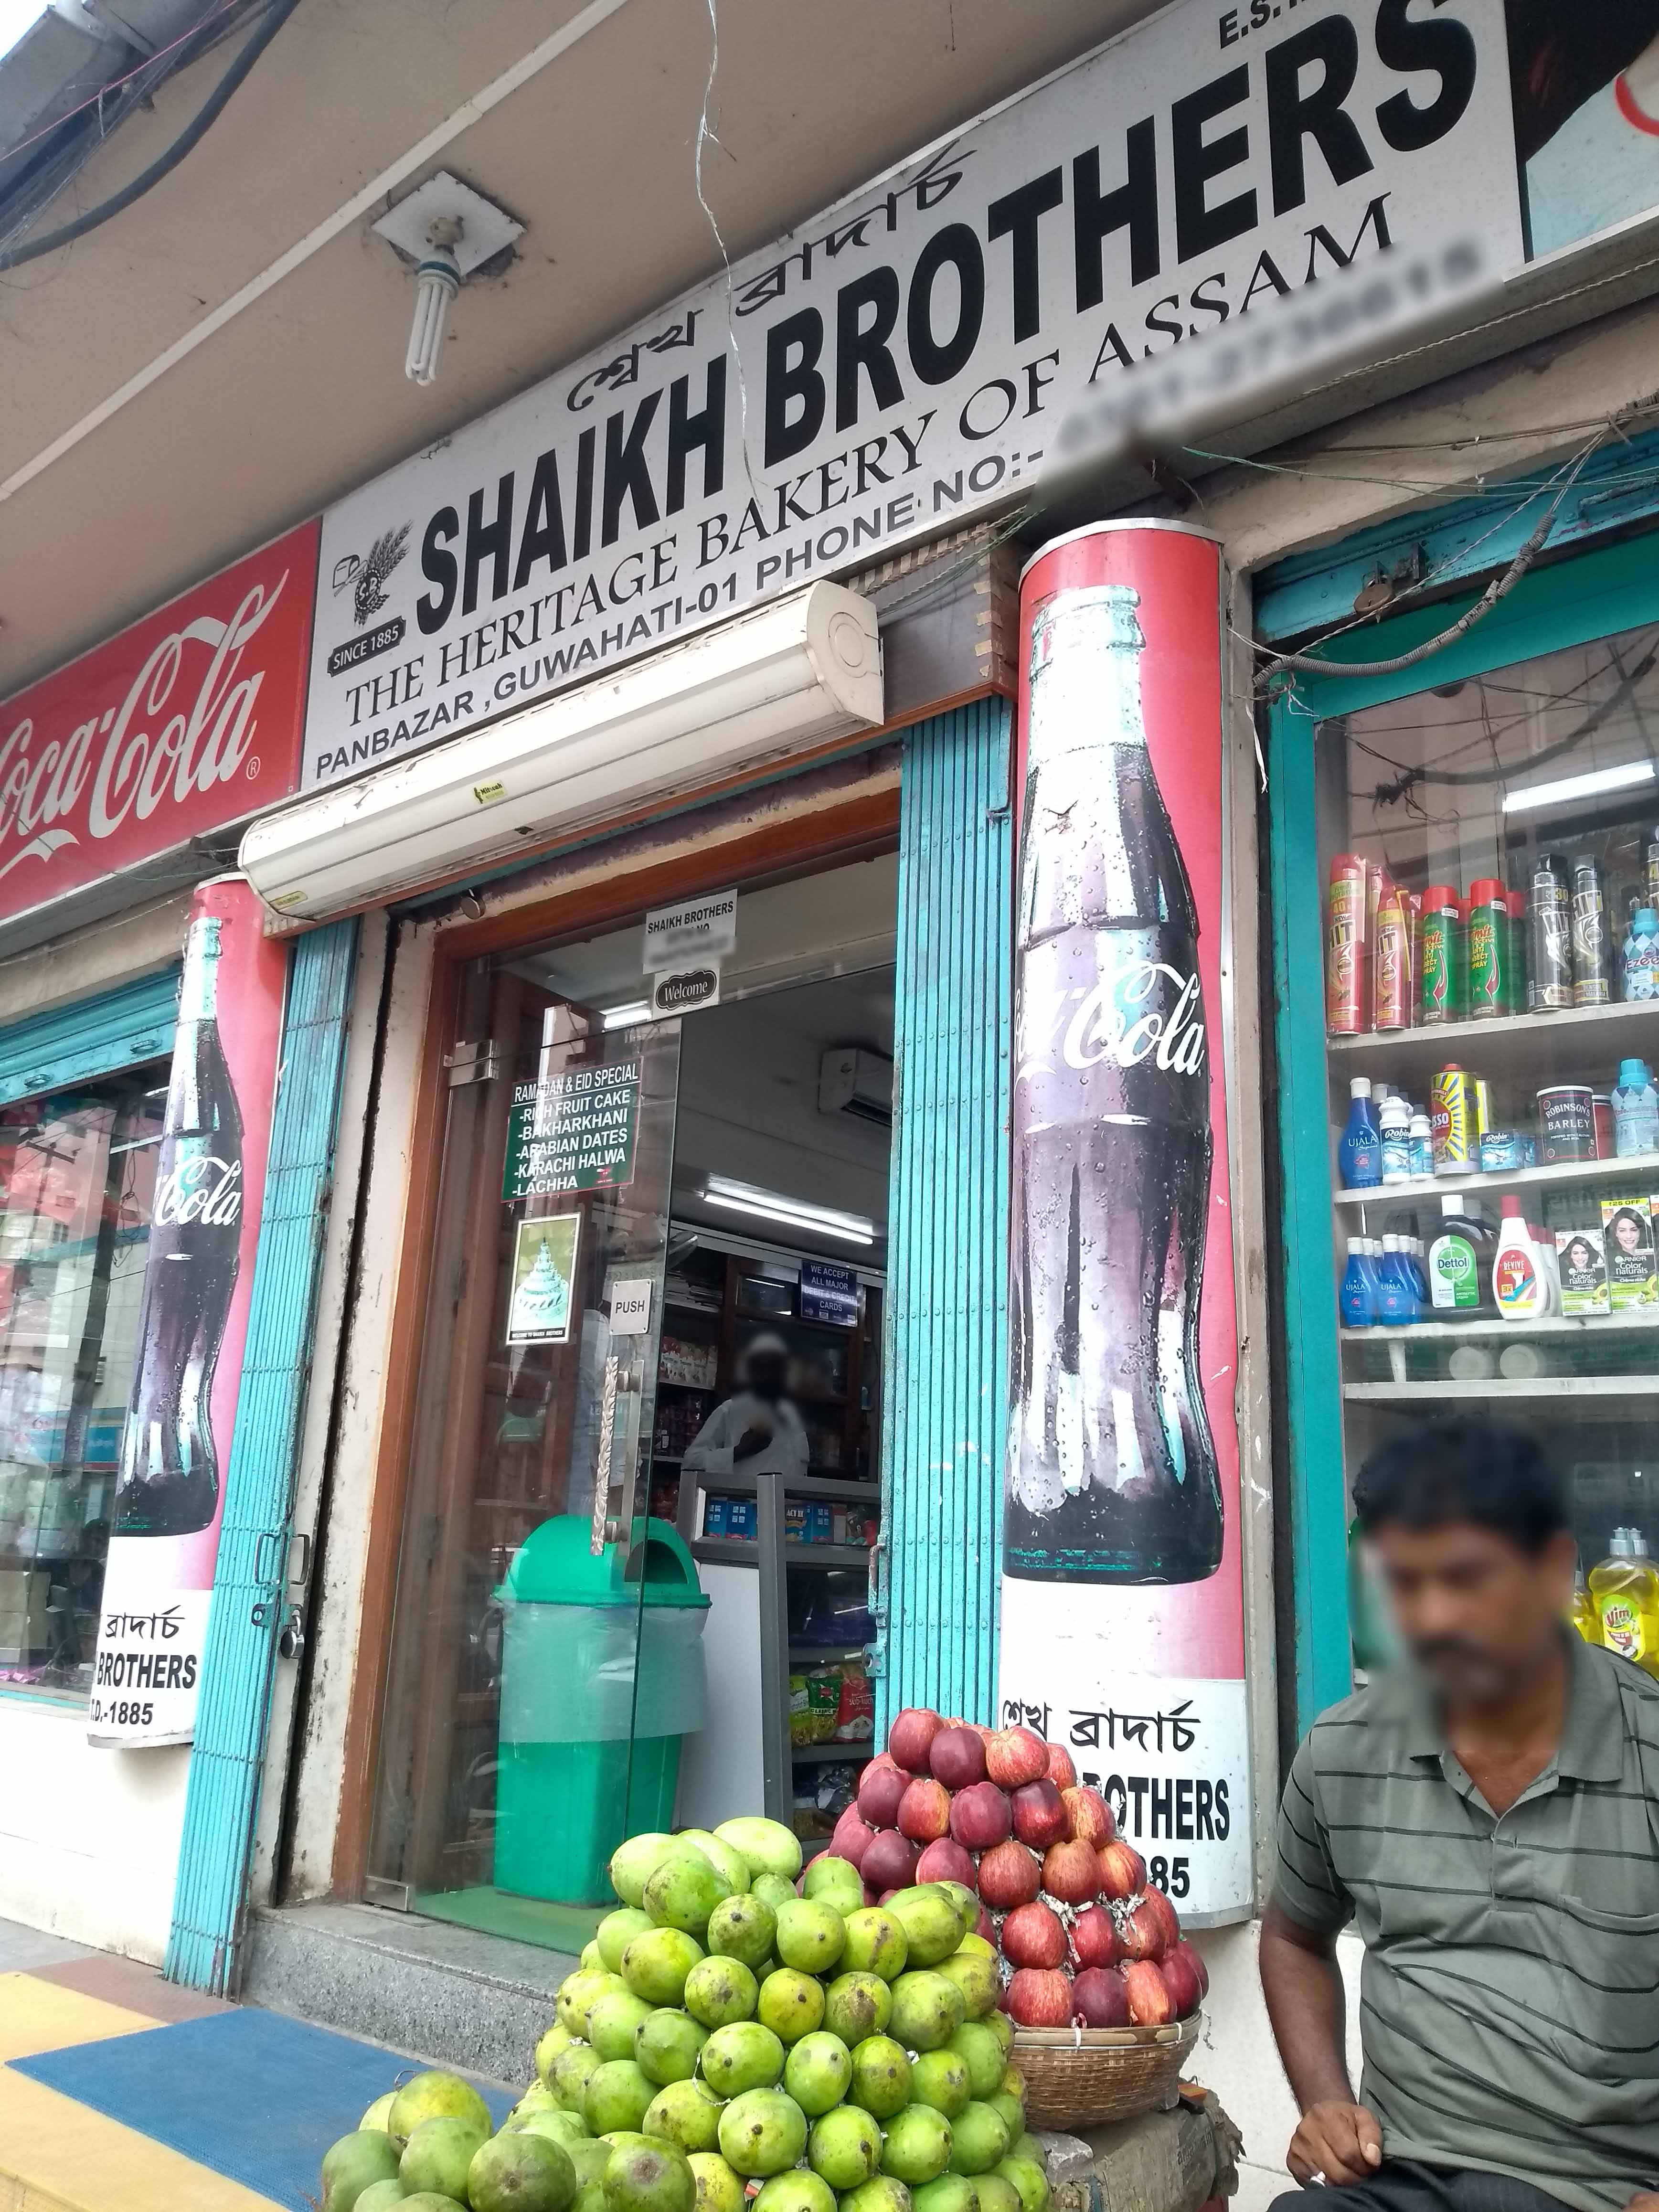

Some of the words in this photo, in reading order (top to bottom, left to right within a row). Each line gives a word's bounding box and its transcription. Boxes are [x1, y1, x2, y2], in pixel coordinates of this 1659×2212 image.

[416, 353, 727, 635] SHAIKH
[764, 0, 1477, 469] BROTHERS
[346, 659, 425, 727] THE
[437, 533, 679, 687] HERITAGE
[696, 409, 937, 569] BAKERY
[959, 349, 1060, 441] OF
[1088, 191, 1395, 385] ASSAM
[317, 690, 474, 779] PANBAZAR
[756, 492, 915, 590] PHONE
[333, 640, 367, 670] SINCE
[371, 625, 399, 651] 1885
[648, 915, 682, 934] SHAIKH
[684, 901, 734, 925] BROTHERS
[664, 980, 708, 1002] Welcome
[514, 1078, 564, 1103] RAMADAN
[565, 1076, 573, 1093] &
[575, 1073, 592, 1091] EID
[594, 1063, 638, 1087] SPECIAL
[555, 1096, 592, 1116] FRUIT
[594, 1089, 631, 1109] CAKE
[1385, 1127, 1409, 1141] Robin
[1548, 1119, 1590, 1130] BARLEY
[582, 1127, 627, 1150] DATES
[1348, 1135, 1377, 1147] UJALA
[1486, 1133, 1509, 1144] Robin
[578, 1147, 626, 1170] HALWA
[811, 1265, 822, 1274] WE
[823, 1268, 849, 1280] ACCEPT
[1438, 1257, 1467, 1269] Dettol
[1503, 1260, 1525, 1271] REVIVE
[811, 1276, 824, 1286] ALL
[826, 1280, 849, 1291] MAJOR
[804, 1287, 825, 1297] DEBIT
[832, 1291, 856, 1304] CREDIT
[819, 1300, 842, 1312] CARDS
[616, 1300, 645, 1314] PUSH
[97, 1651, 197, 1689] BROTHERS
[1083, 1772, 1230, 1841] OTHERS
[1142, 1856, 1190, 1898] 85
